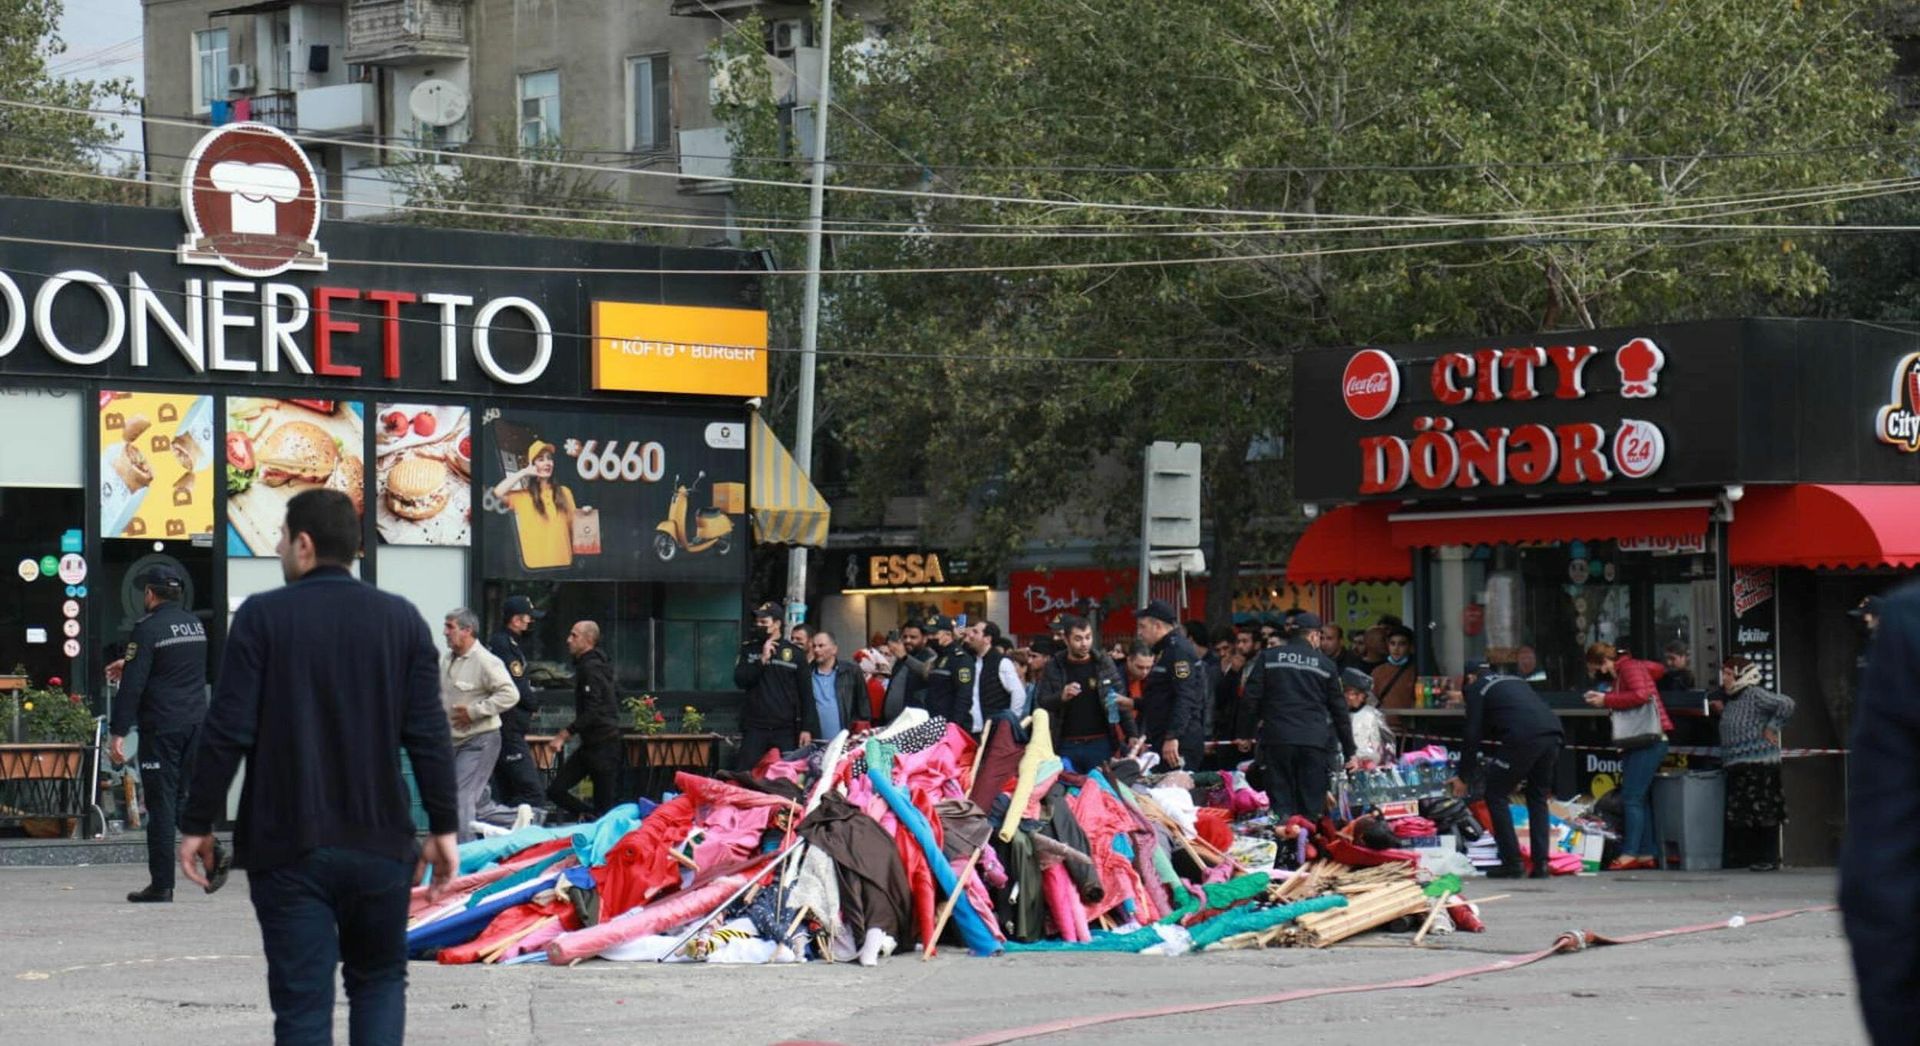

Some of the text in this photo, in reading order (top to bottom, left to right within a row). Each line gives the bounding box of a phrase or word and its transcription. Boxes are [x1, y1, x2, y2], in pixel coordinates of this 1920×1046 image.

[691, 345, 756, 361] BURGER
[1347, 372, 1389, 397] Coca-Cola
[1431, 345, 1598, 404] CITY
[1888, 409, 1920, 445] City
[1359, 416, 1614, 494] DÖNƏR
[1627, 438, 1650, 460] 24
[870, 553, 944, 586] ESSA
[170, 622, 206, 637] POLIS
[1278, 652, 1319, 666] POLIS
